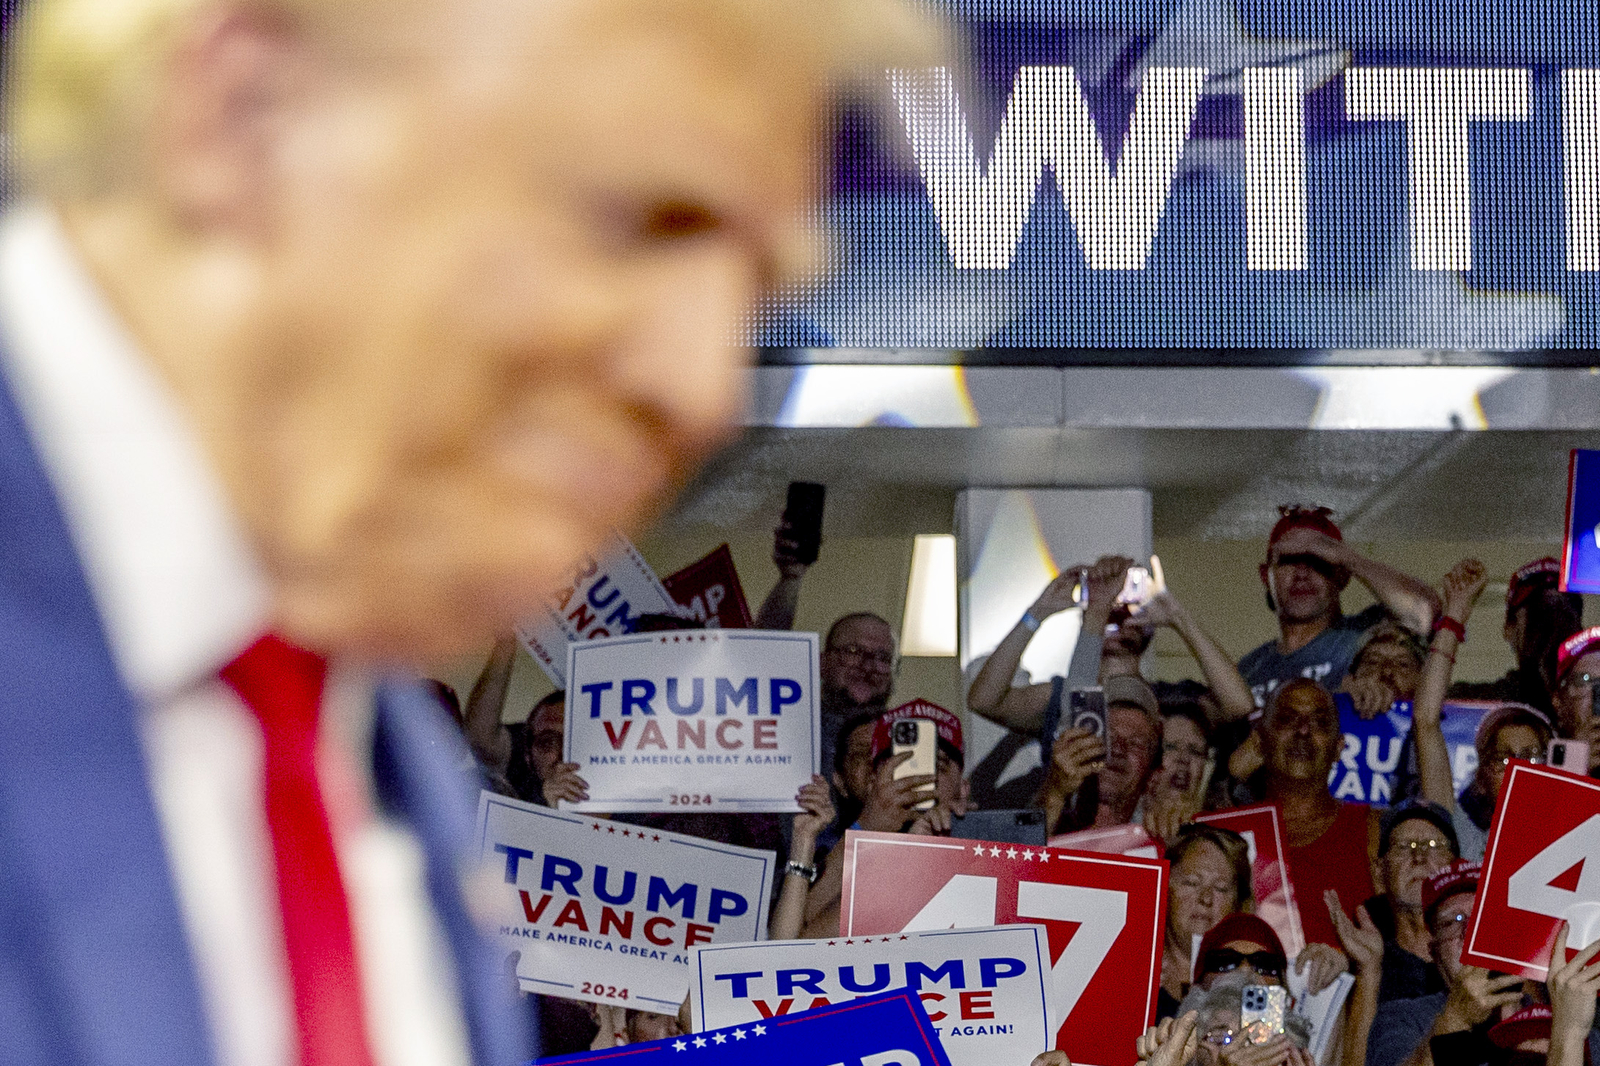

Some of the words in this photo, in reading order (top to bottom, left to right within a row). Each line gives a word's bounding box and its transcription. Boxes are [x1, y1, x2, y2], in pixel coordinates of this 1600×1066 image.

[581, 677, 803, 720] TRUMP
[603, 718, 780, 751] VANCE
[669, 794, 713, 806] 2024
[494, 843, 749, 925] TRUMP
[518, 890, 716, 950] VANCE
[546, 931, 614, 953] AMERICA
[619, 944, 668, 962] GREAT
[580, 982, 630, 1002] 2024
[715, 957, 1027, 998] TRUMP
[751, 990, 996, 1022] VCE
[951, 1024, 1014, 1037] AGAIN!
